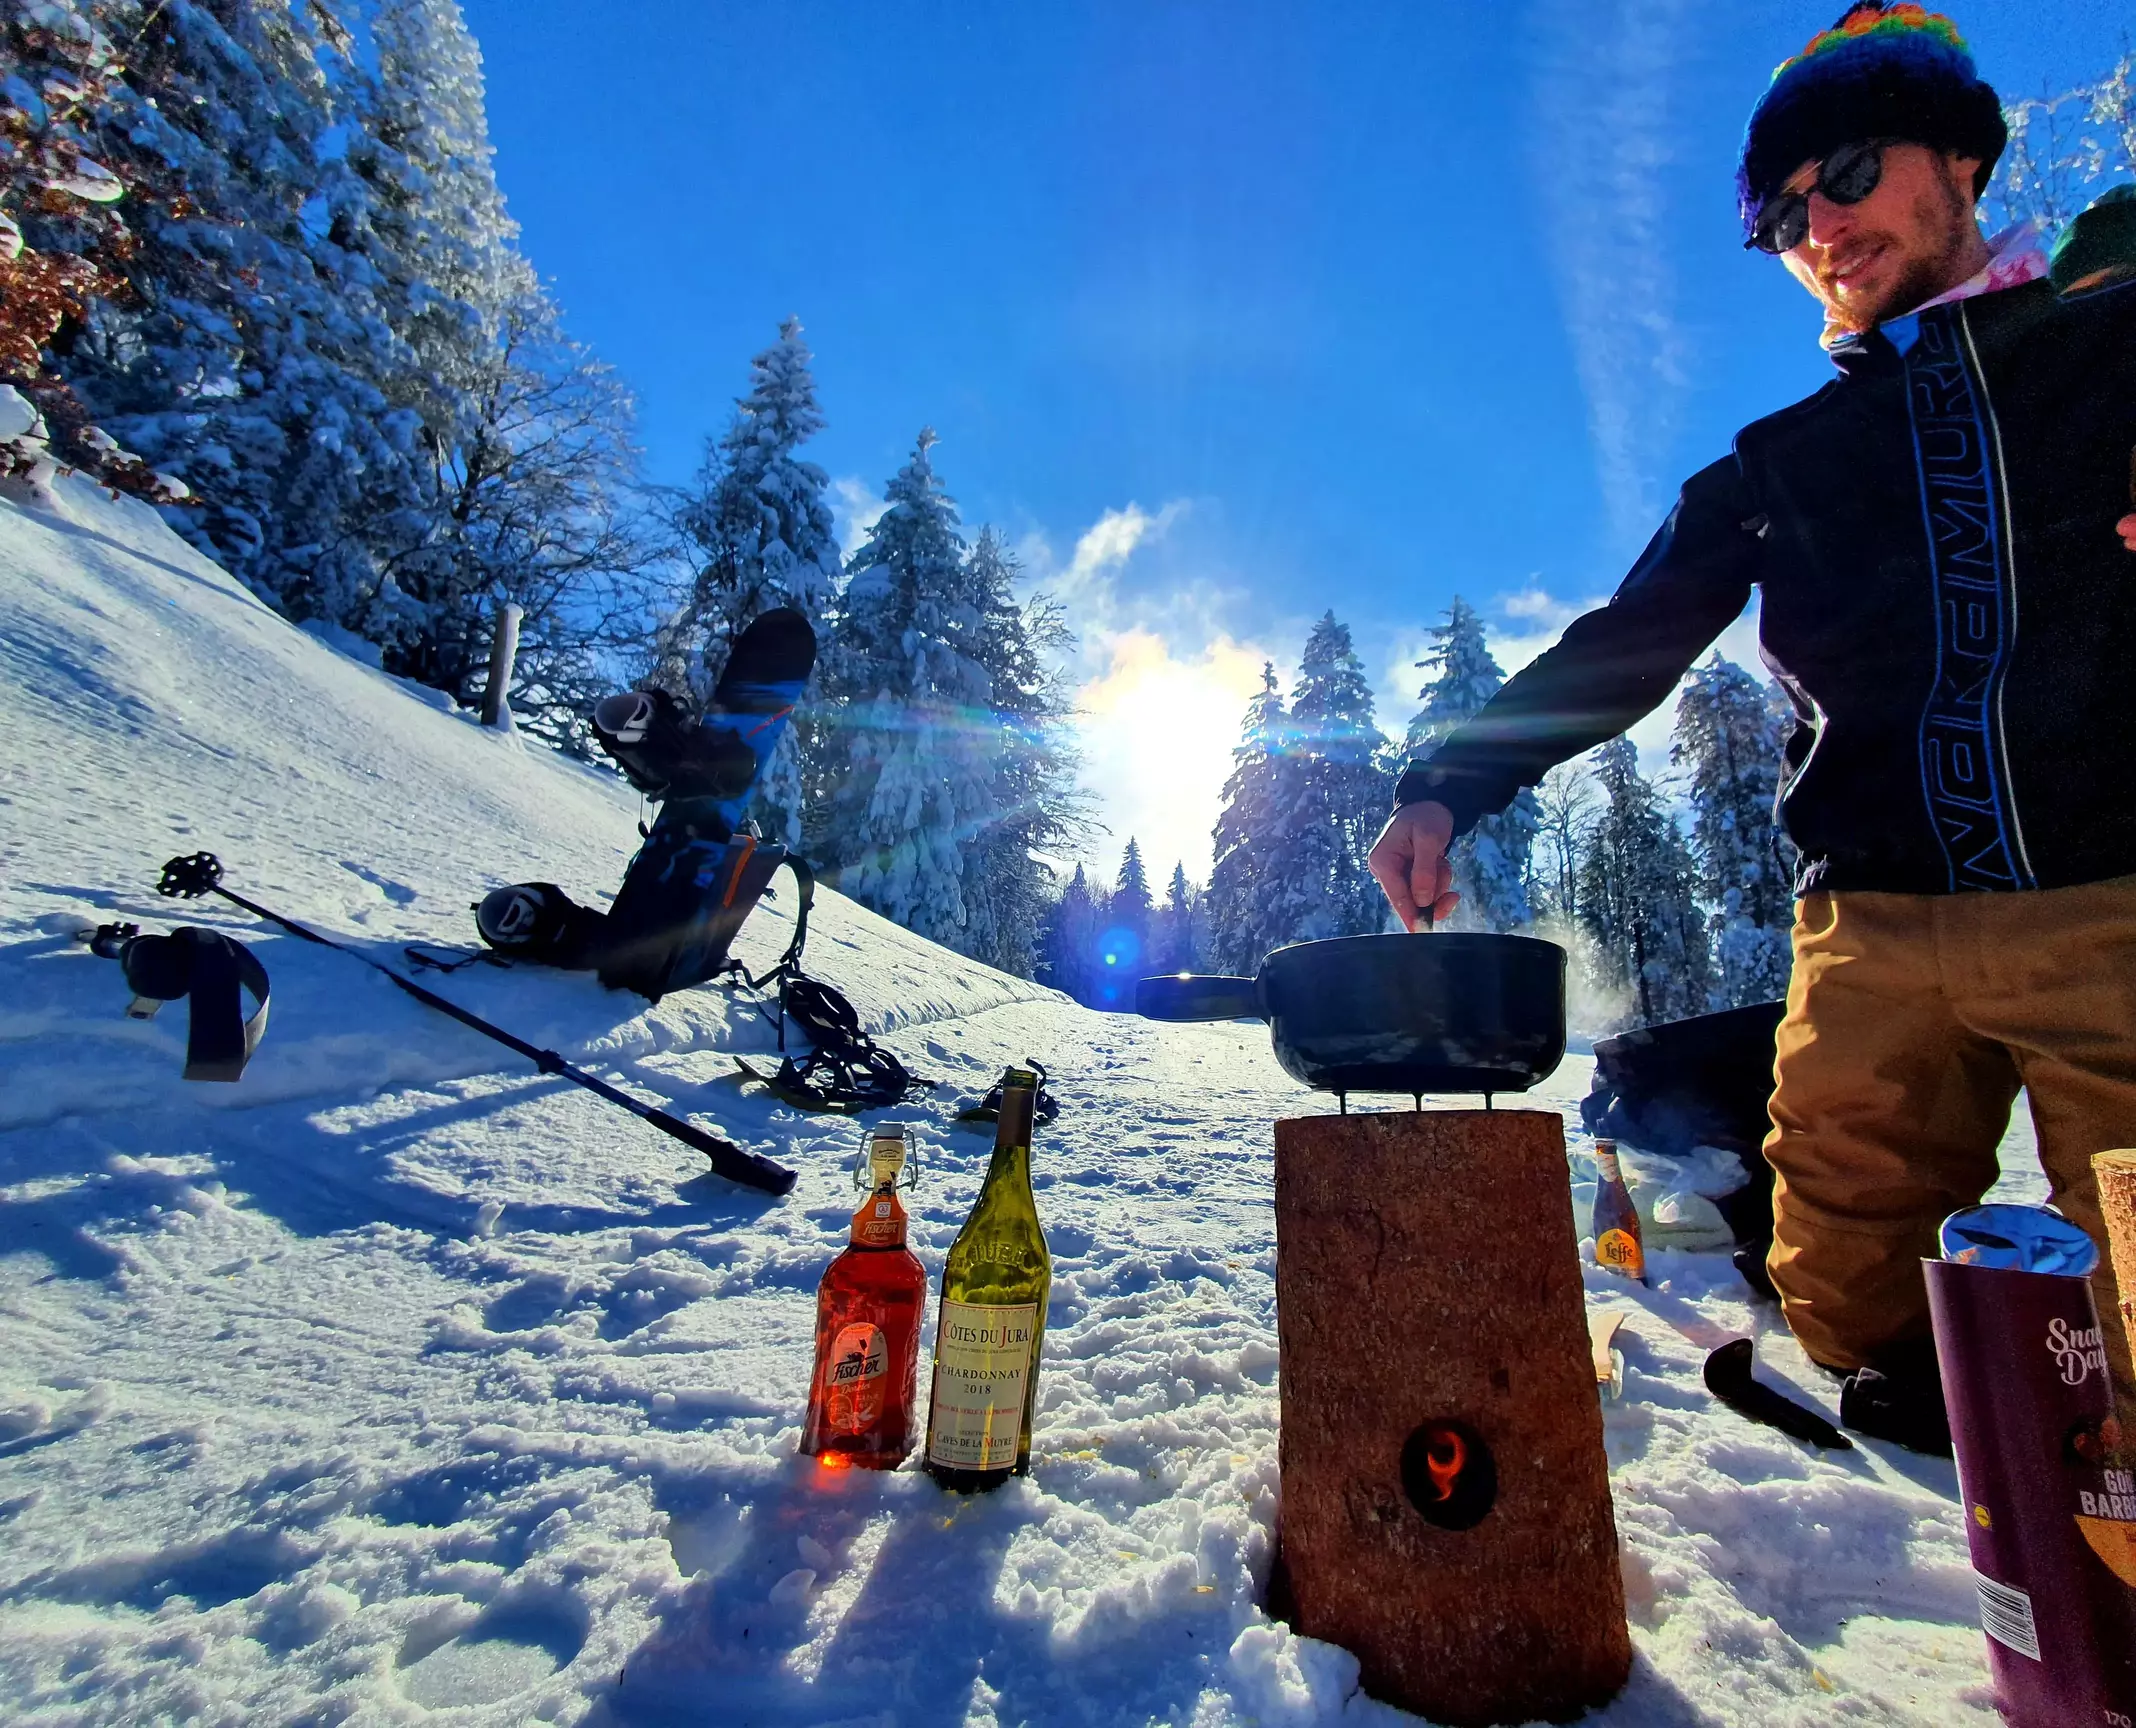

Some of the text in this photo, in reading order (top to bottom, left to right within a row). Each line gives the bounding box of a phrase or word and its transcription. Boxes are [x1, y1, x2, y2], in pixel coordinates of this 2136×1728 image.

[862, 1219, 900, 1236] Fischer
[1604, 1242, 1634, 1264] Leffe
[943, 1320, 977, 1343] CÔTES
[980, 1329, 999, 1344] DU
[998, 1325, 1029, 1349] JURA
[831, 1353, 881, 1383] Fischer
[941, 1363, 1022, 1380] CHARDONNAY
[2055, 1348, 2108, 1386] Day
[963, 1383, 992, 1395] 2018
[936, 1431, 1013, 1449] CAVES DE LA MUYRE
